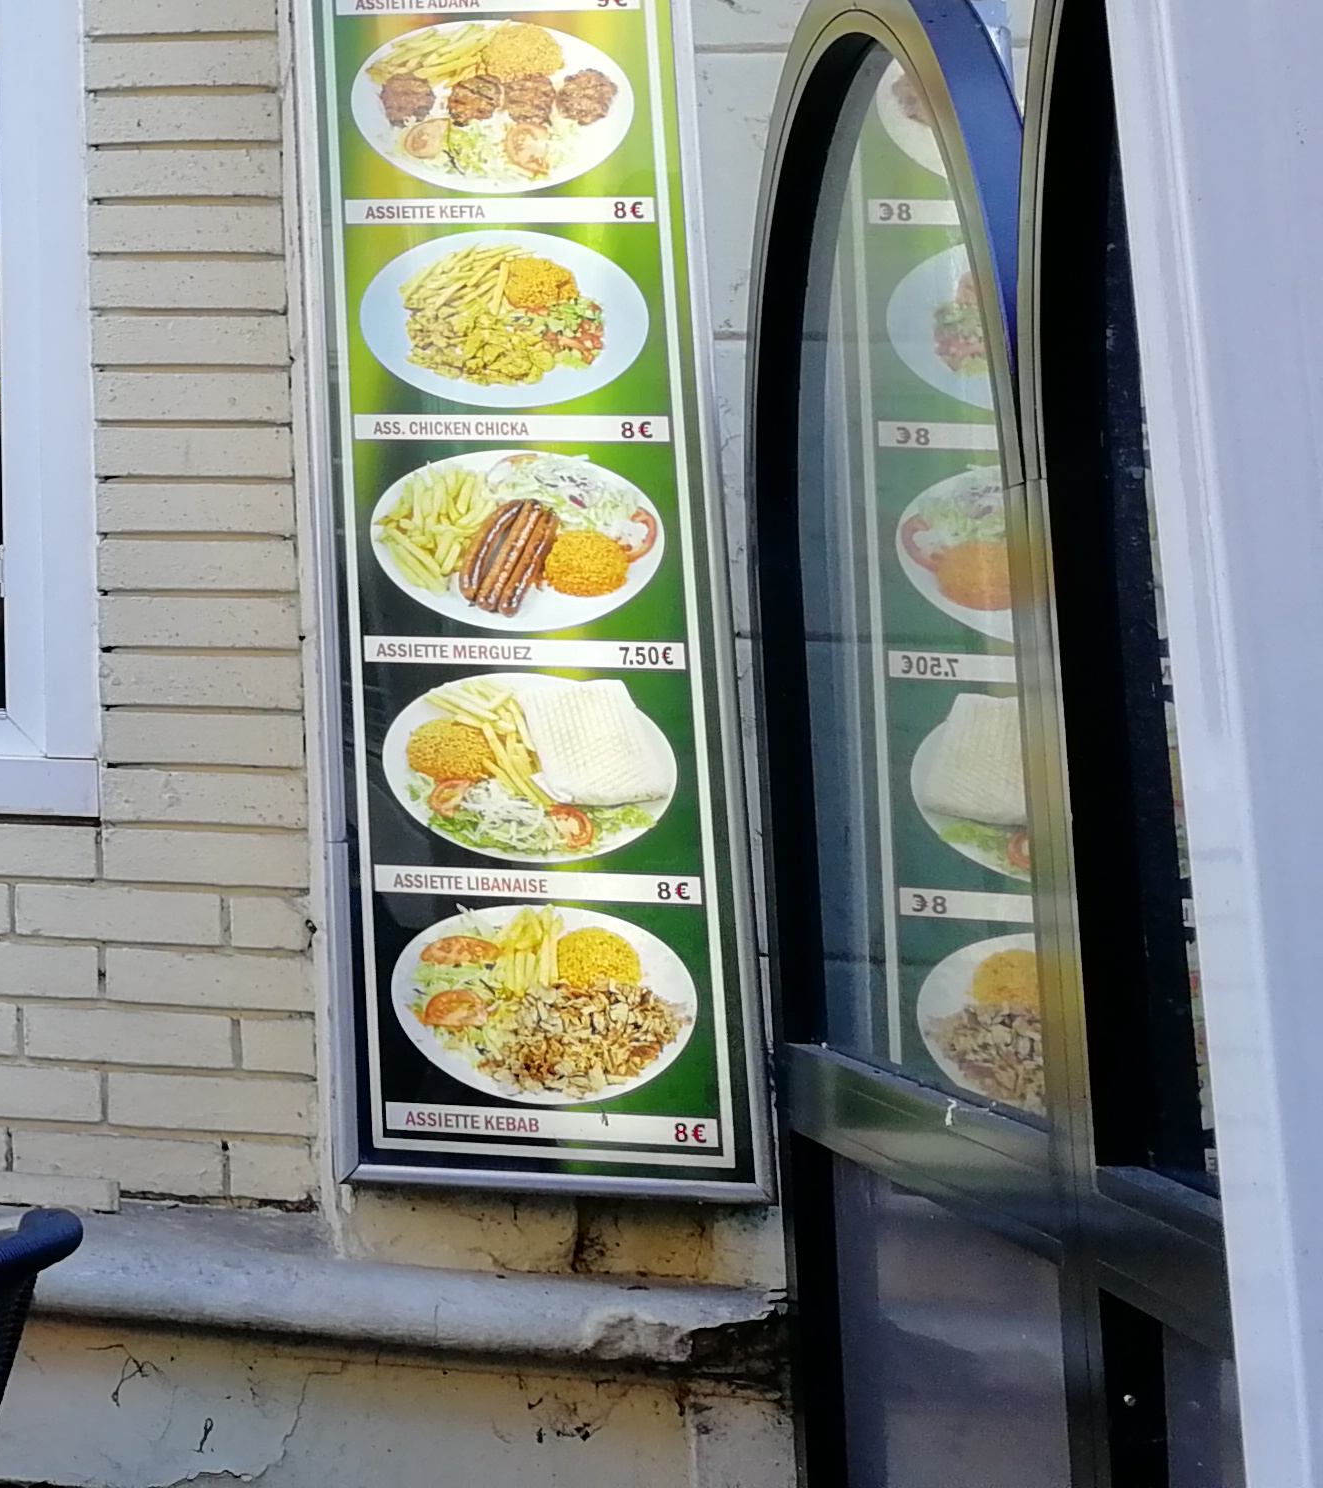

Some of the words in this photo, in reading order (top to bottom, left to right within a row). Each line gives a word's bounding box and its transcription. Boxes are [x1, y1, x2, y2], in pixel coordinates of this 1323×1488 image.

[365, 204, 436, 219] ASSIETTE
[439, 204, 485, 219] KEFTA
[373, 420, 406, 435] ASS.
[409, 421, 472, 436] CHICKEN
[474, 421, 529, 436] CHICKA
[376, 642, 449, 659] ASSIETTE
[452, 644, 532, 661] MERGUEZ
[618, 646, 674, 666] 7.50€
[393, 873, 465, 891] ASSIETTE
[467, 875, 548, 894] LIBANAISE
[405, 1110, 481, 1130] ASSIETTE
[484, 1114, 540, 1133] KEBAB
